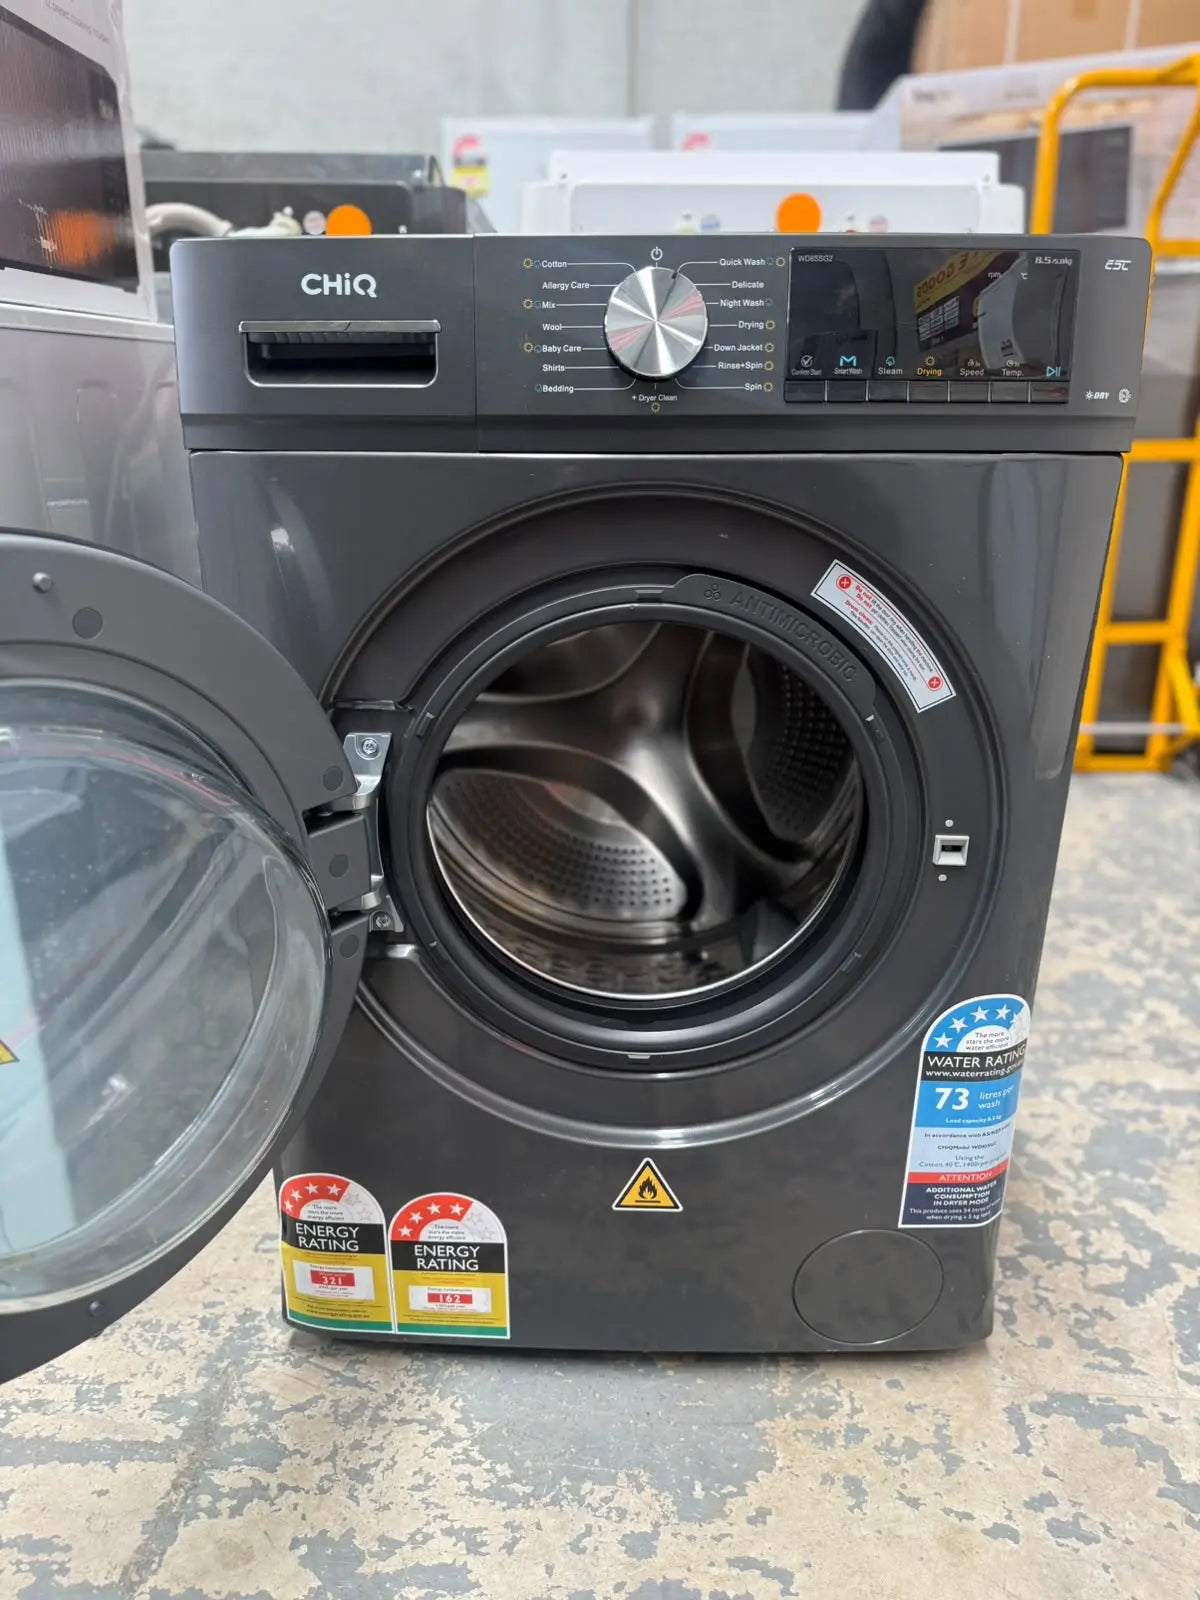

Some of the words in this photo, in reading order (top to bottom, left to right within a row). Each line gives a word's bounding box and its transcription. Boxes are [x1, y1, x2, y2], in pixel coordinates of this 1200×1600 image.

[301, 273, 377, 297] CHiQ
[543, 282, 569, 290] Allergy
[720, 300, 741, 308] Night
[739, 321, 764, 330] Drying
[917, 368, 942, 376] Drying
[960, 368, 984, 376] Speed
[1002, 368, 1024, 378] Temp.
[543, 385, 574, 393] Bedding
[854, 584, 863, 592] Do
[862, 590, 872, 600] not
[855, 592, 864, 601] Do
[862, 599, 872, 608] not
[928, 1056, 980, 1068] WATER
[985, 1044, 1025, 1067] RATING
[936, 1087, 970, 1110] 73
[980, 1091, 1001, 1100] litres
[978, 1099, 1000, 1109] wash
[939, 1171, 992, 1180] ATTENTION
[976, 1181, 996, 1191] WATER
[934, 1191, 990, 1199] CONSUMPTION
[969, 1197, 989, 1205] MODE
[296, 1222, 359, 1238] ENERGY
[298, 1238, 359, 1251] RATING
[414, 1245, 480, 1257] ENERGY
[417, 1259, 479, 1270] RATING
[322, 1276, 342, 1285] 321
[440, 1294, 460, 1303] 162
